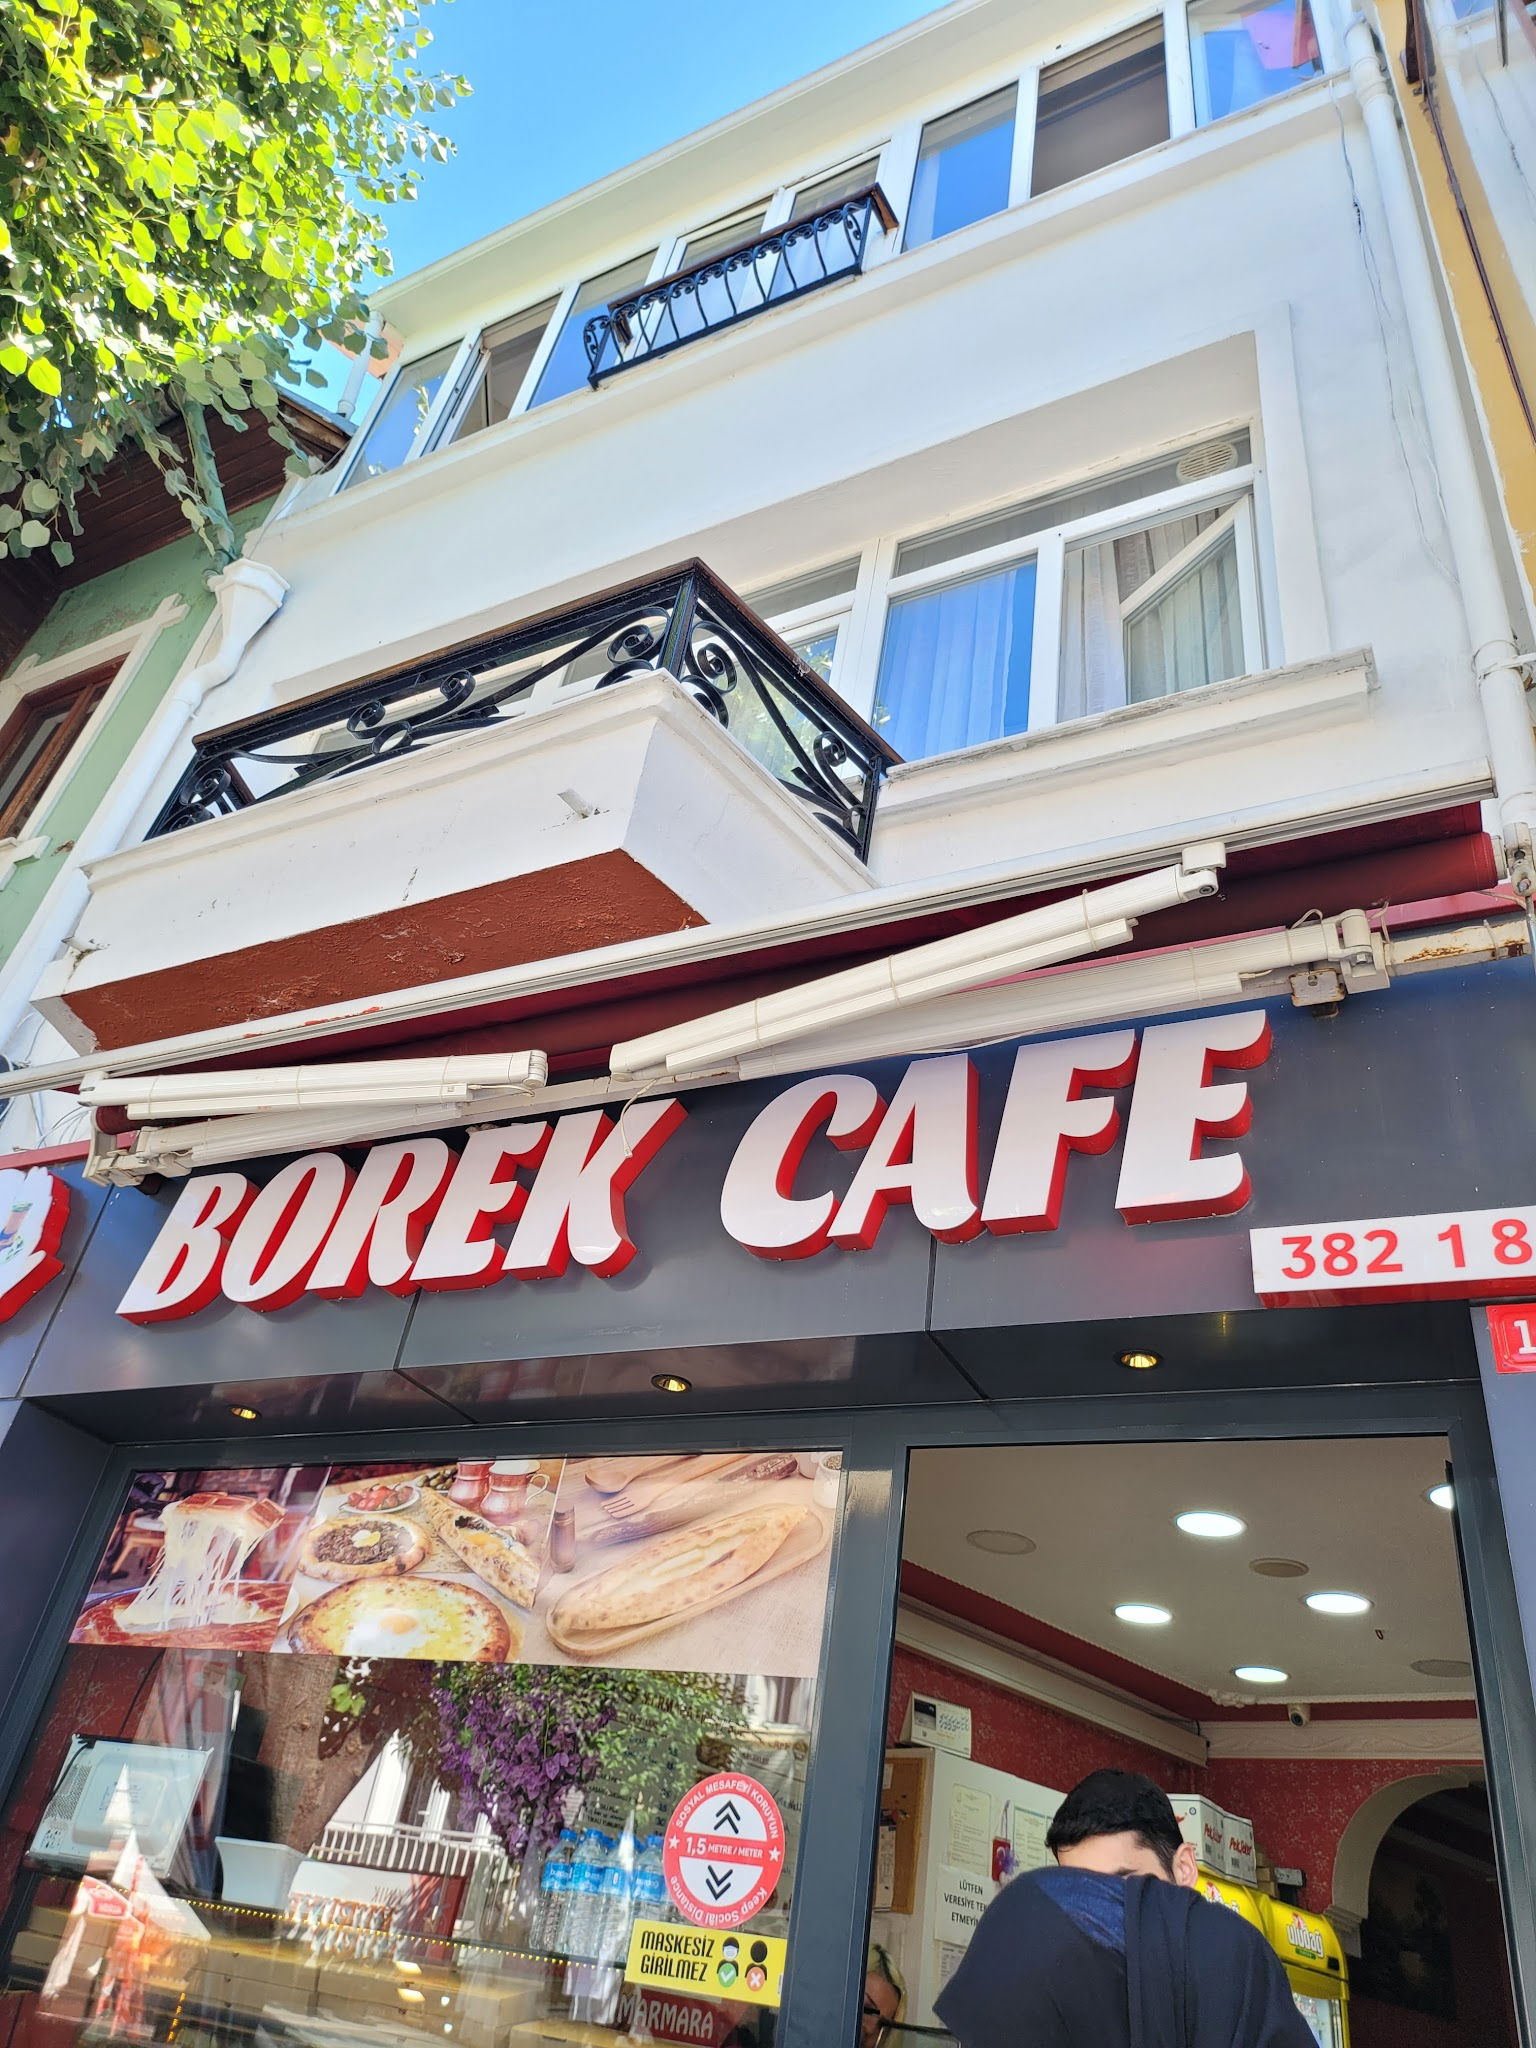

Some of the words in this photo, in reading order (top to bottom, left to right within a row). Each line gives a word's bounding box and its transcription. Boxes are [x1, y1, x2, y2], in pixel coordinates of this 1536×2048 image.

[115, 1098, 686, 1323] BOREK
[720, 1009, 1273, 1261] CAFE
[1282, 1229, 1403, 1279] 382
[676, 1791, 705, 1828] SOSYAL
[750, 1789, 779, 1839] KORUYUN
[686, 1836, 707, 1856] 1,5
[708, 1843, 733, 1855] METRE
[738, 1846, 763, 1859] METER
[670, 1876, 704, 1922] Distance
[741, 1886, 768, 1915] Keep
[944, 1892, 975, 1910] VERESİYE
[959, 1879, 983, 1896] LÜTFEN
[705, 1910, 739, 1926] Social
[640, 1930, 715, 1958] MASKESİZ
[640, 1954, 708, 1982] GİRİLMEZ
[617, 1994, 714, 2040] MARMARA
